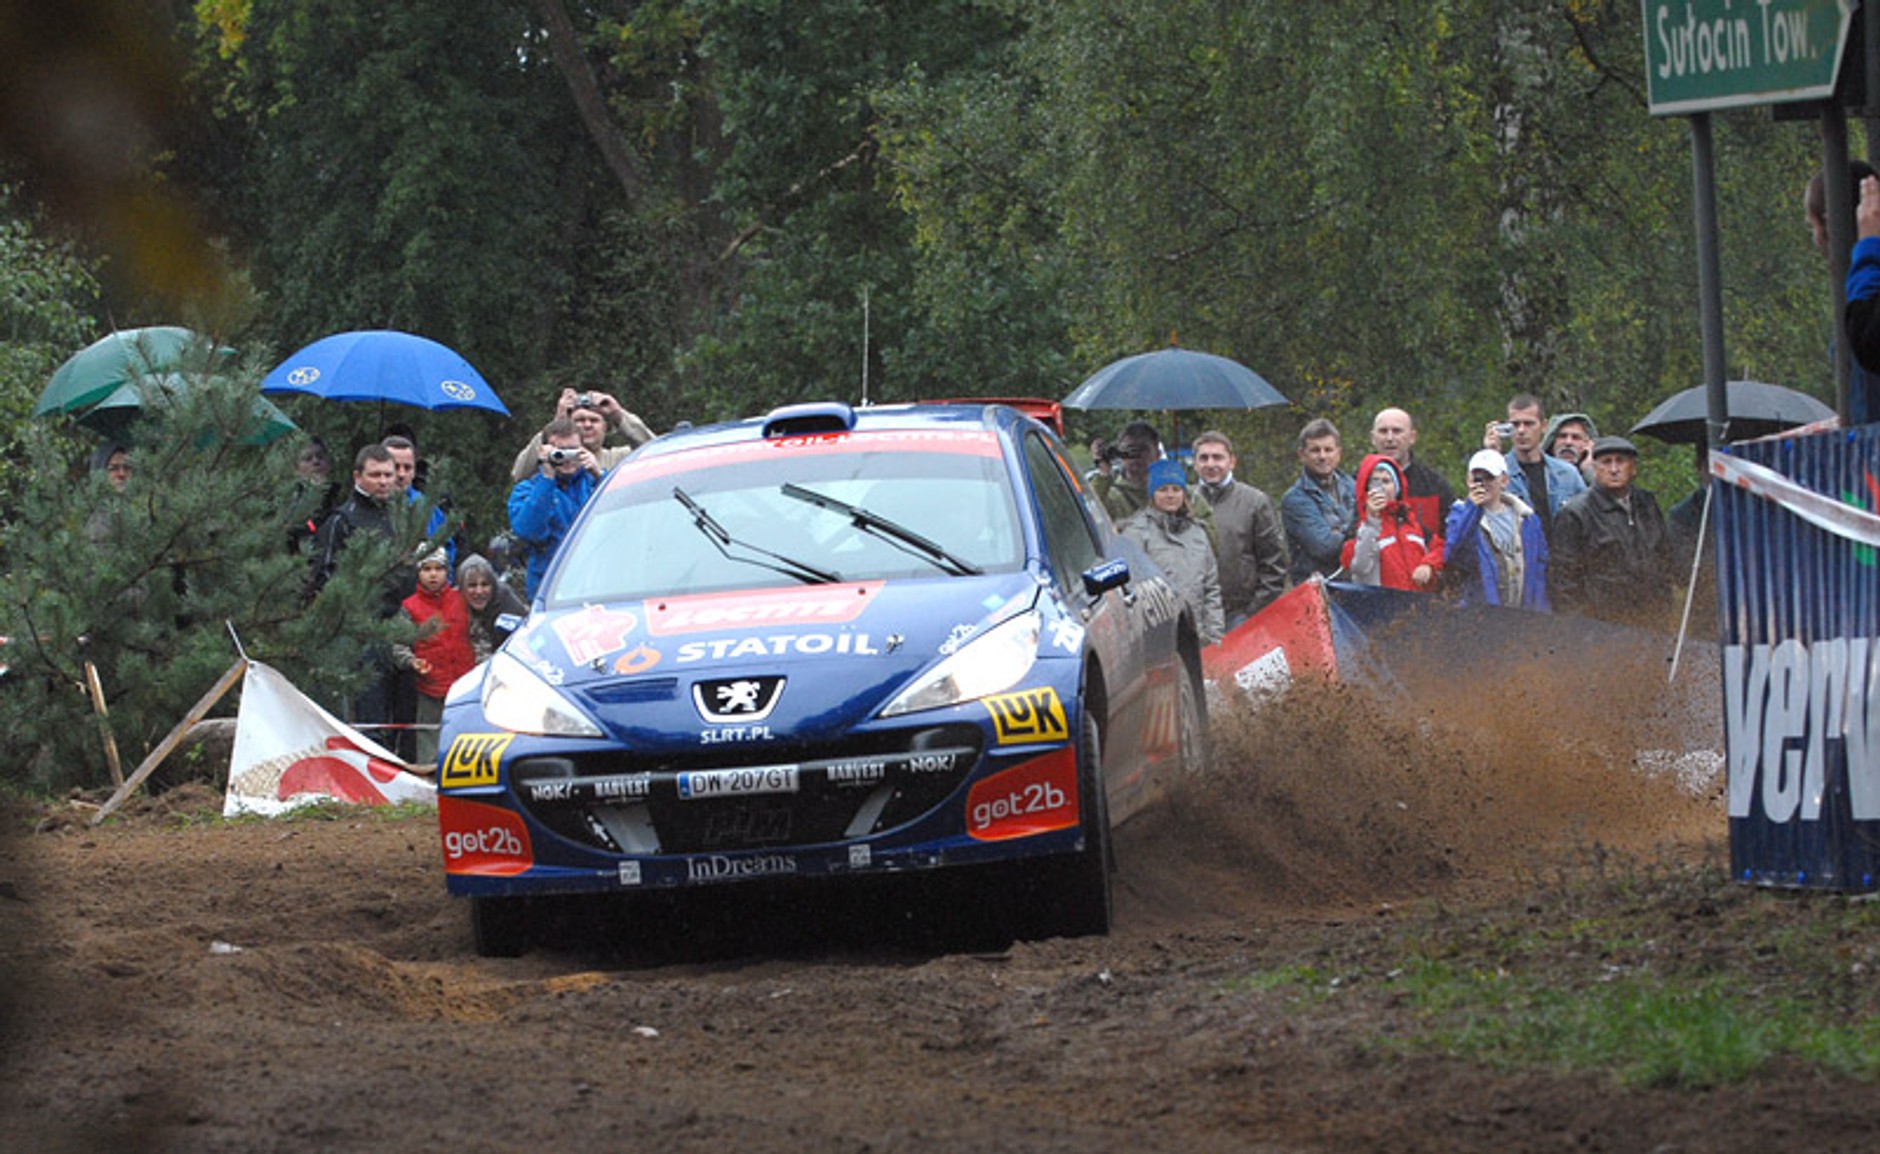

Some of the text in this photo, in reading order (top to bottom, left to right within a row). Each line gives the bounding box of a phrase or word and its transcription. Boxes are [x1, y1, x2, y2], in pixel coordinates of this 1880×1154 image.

[1657, 0, 1750, 78] Sułocin
[700, 726, 774, 744] SLRT.PL
[692, 768, 793, 794] DW 207GT
[973, 782, 1065, 829] got2b
[445, 827, 522, 858] got2b
[687, 855, 796, 880] InDreams
